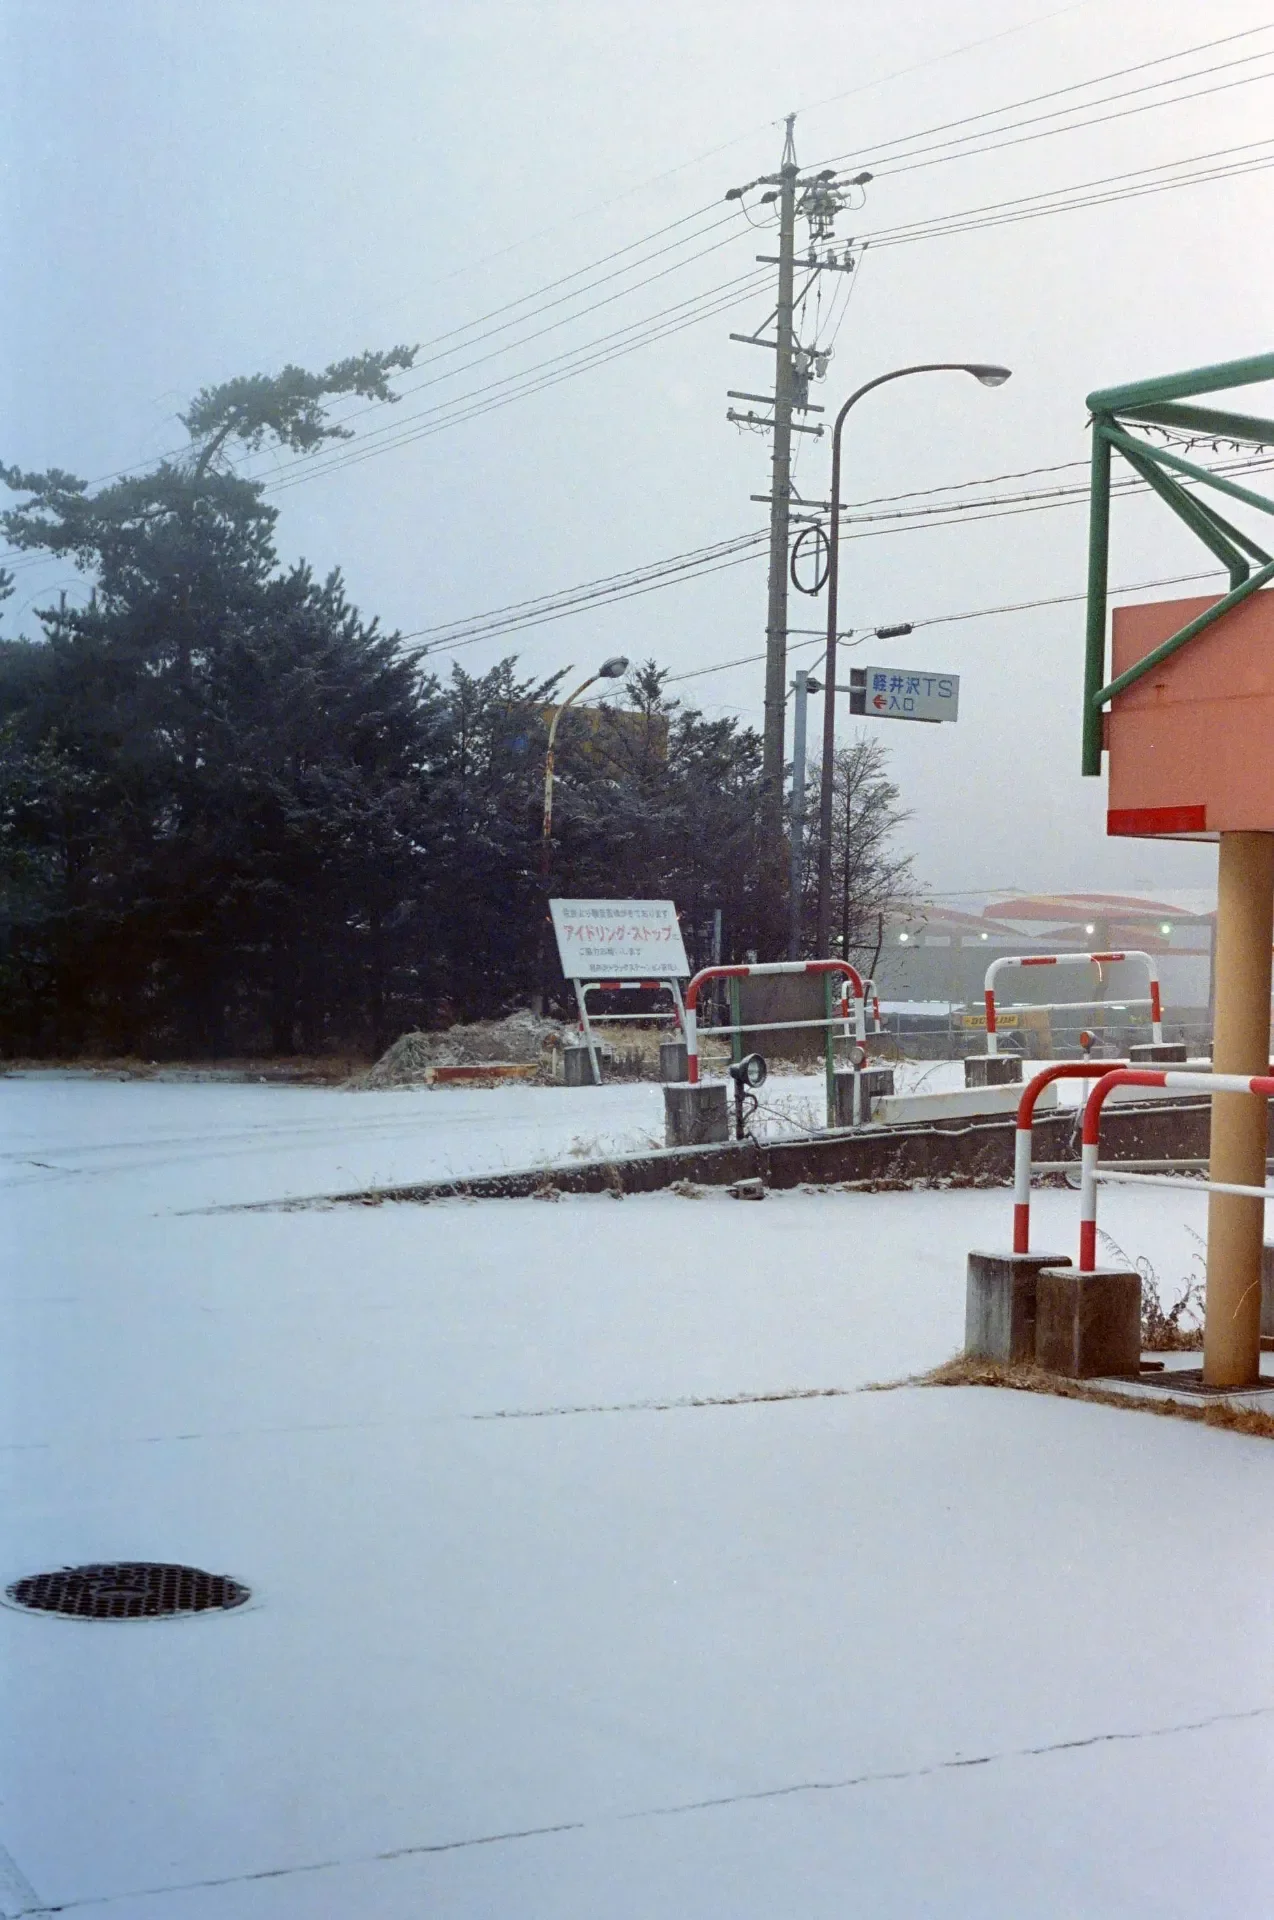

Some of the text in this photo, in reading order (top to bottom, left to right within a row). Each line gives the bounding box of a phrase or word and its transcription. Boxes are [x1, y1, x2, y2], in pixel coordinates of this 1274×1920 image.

[873, 673, 953, 698] 軽井沢TS
[889, 695, 914, 711] 入口
[971, 1015, 1015, 1025] DULOP
